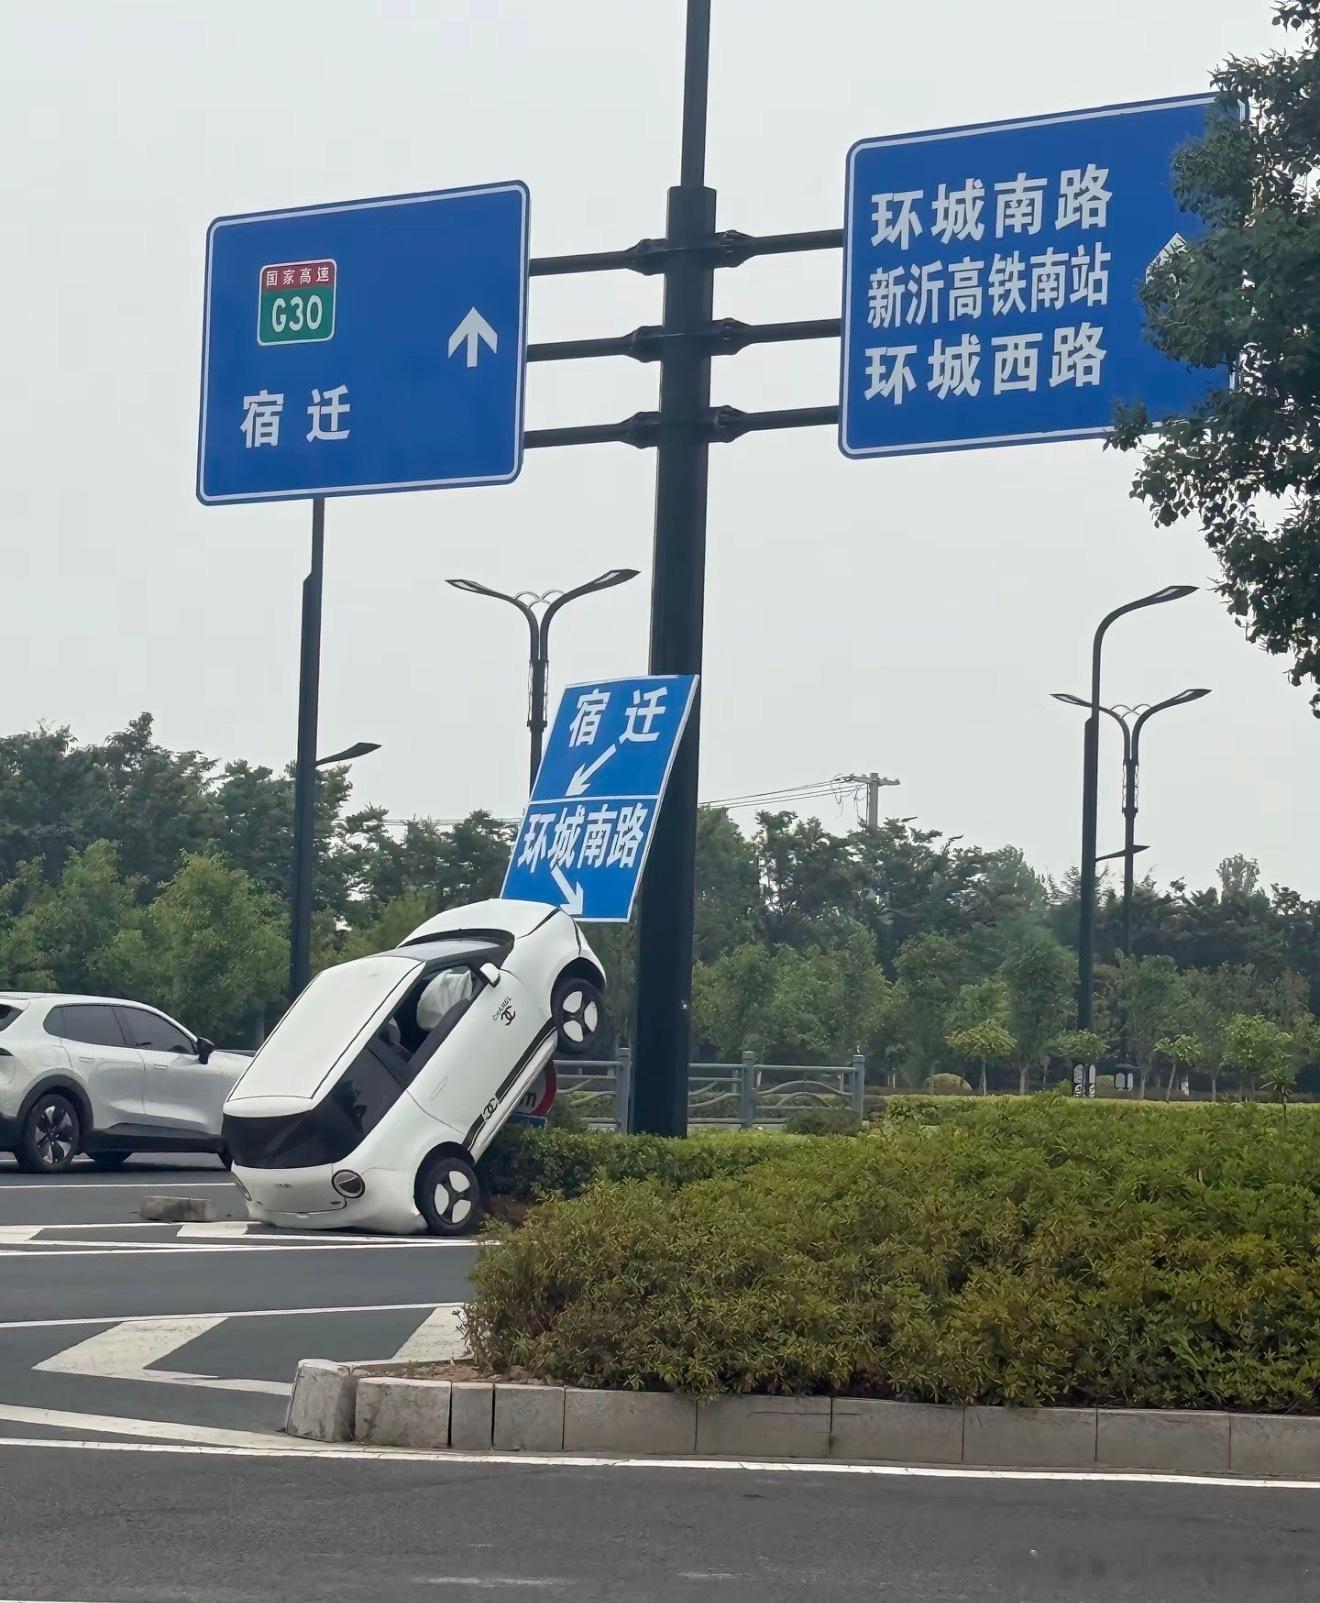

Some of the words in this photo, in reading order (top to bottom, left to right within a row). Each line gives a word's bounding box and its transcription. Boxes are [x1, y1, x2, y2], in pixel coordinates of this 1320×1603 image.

[870, 163, 1113, 251] 环城南路
[266, 266, 330, 287] 国家高速
[867, 241, 1112, 329] 新沂高铁南站
[272, 295, 323, 332] G30
[864, 321, 1107, 405] 环城西路
[240, 384, 351, 449] 宿迁
[568, 686, 668, 748] 宿迁
[517, 802, 649, 873] 环城南路
